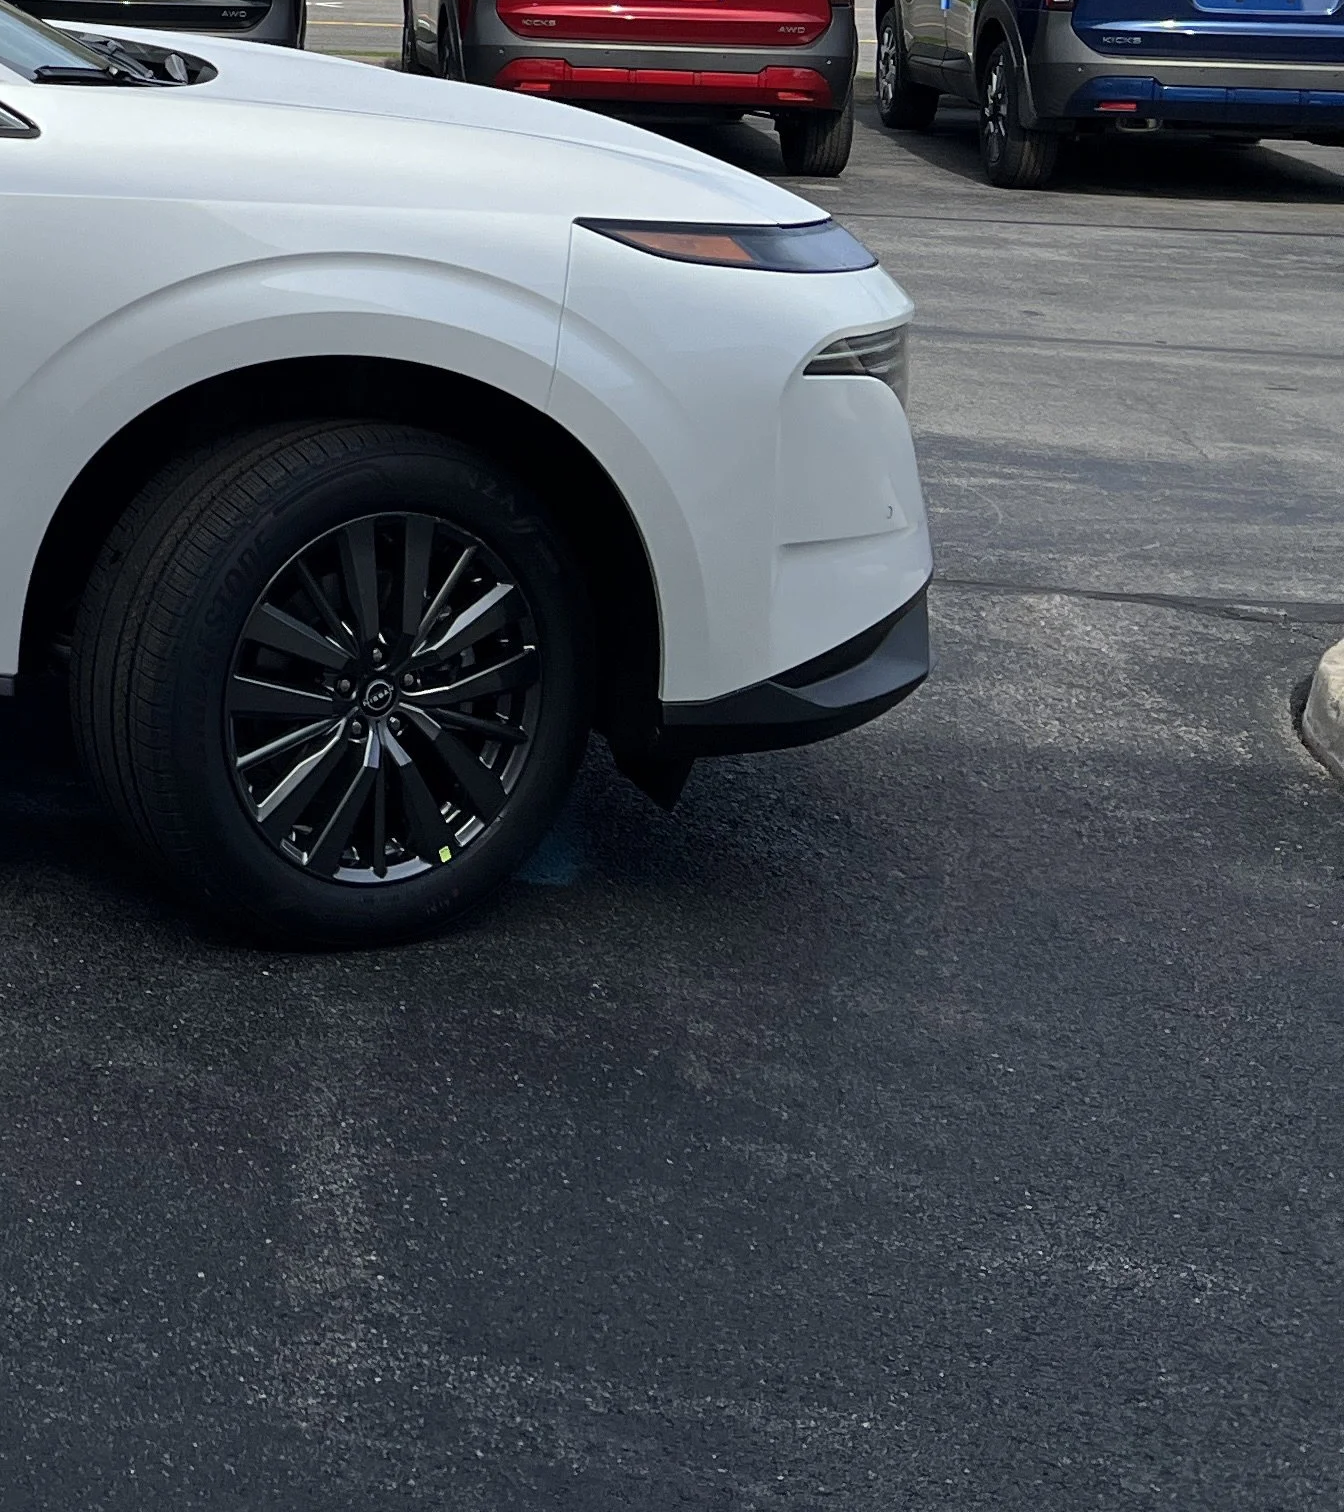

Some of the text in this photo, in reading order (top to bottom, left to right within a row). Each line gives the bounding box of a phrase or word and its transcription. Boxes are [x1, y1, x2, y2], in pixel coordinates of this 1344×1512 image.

[221, 10, 247, 18] AWD
[777, 26, 806, 34] AWD
[1102, 36, 1142, 45] KICKS
